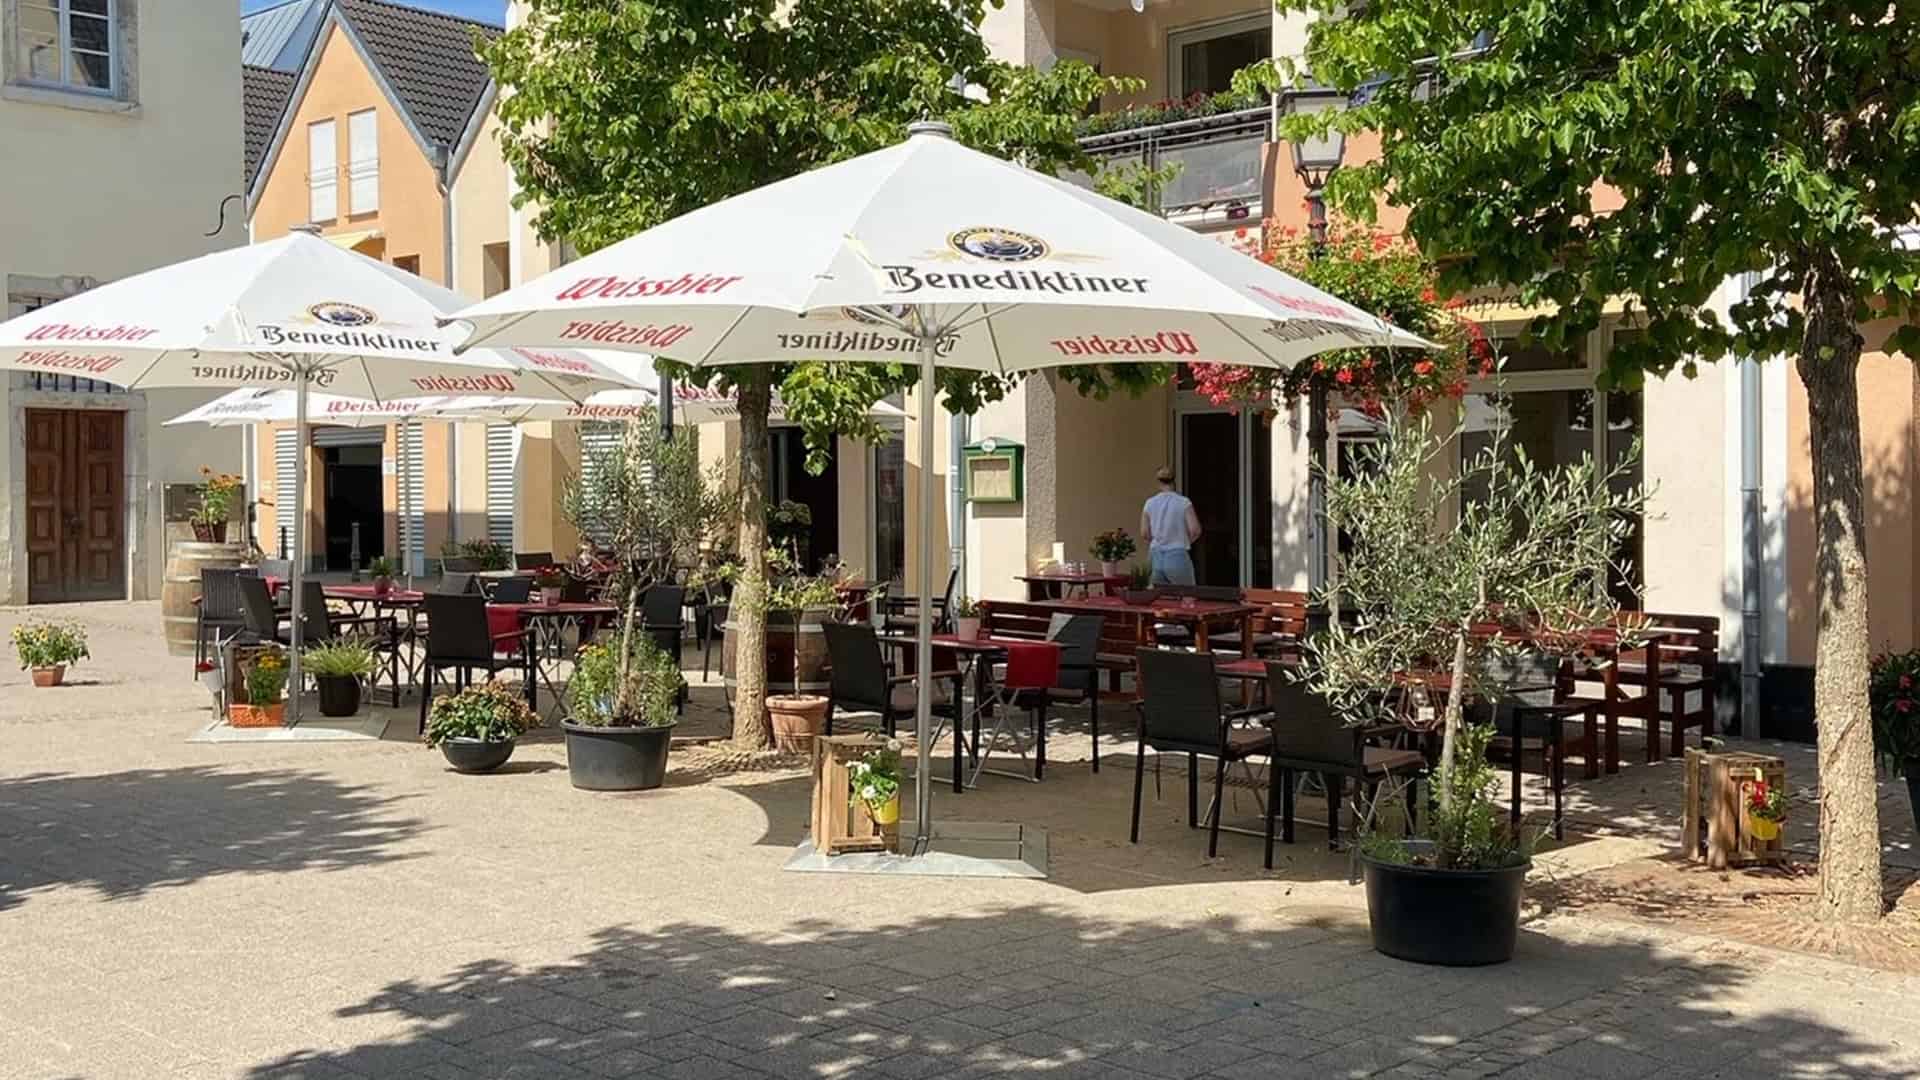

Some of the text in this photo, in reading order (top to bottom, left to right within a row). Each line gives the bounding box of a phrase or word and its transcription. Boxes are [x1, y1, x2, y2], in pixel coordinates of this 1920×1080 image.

[556, 273, 744, 300] Weissbier
[881, 265, 1149, 294] Benediktiner
[24, 323, 160, 341] Weissbier
[256, 324, 441, 352] Benediktiner
